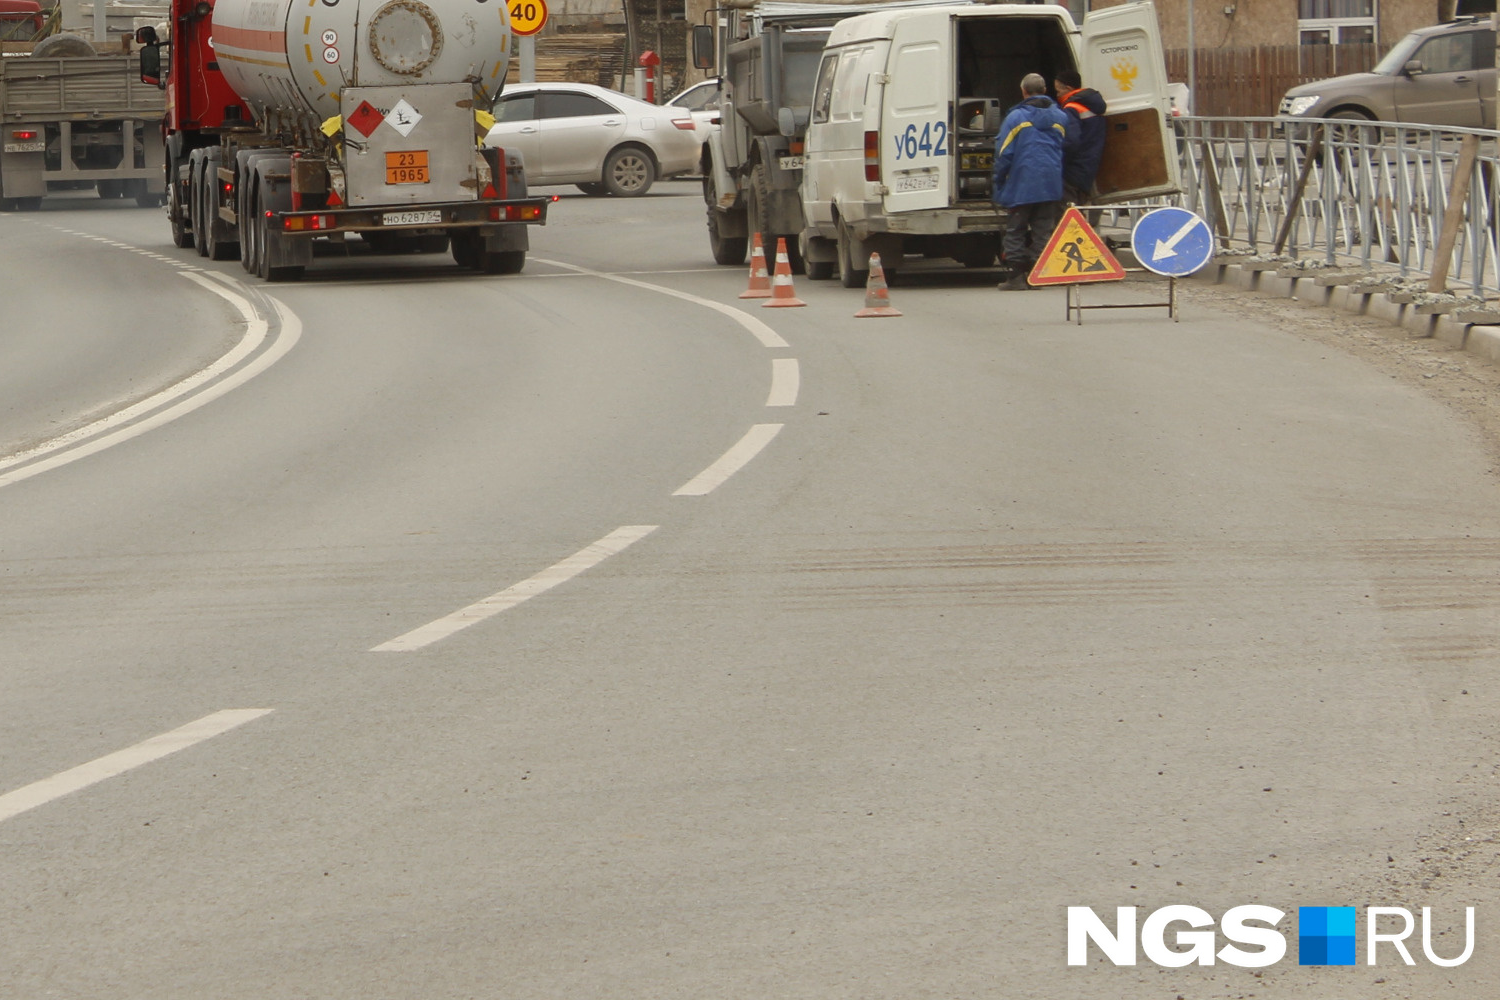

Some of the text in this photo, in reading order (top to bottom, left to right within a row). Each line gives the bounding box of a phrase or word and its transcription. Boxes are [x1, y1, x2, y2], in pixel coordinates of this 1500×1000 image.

[510, 3, 537, 22] 40
[325, 33, 334, 41] 90
[326, 51, 336, 59] 60
[1100, 44, 1139, 55] ОСТОРОЖНО
[399, 153, 415, 166] 23
[392, 168, 424, 182] 1965
